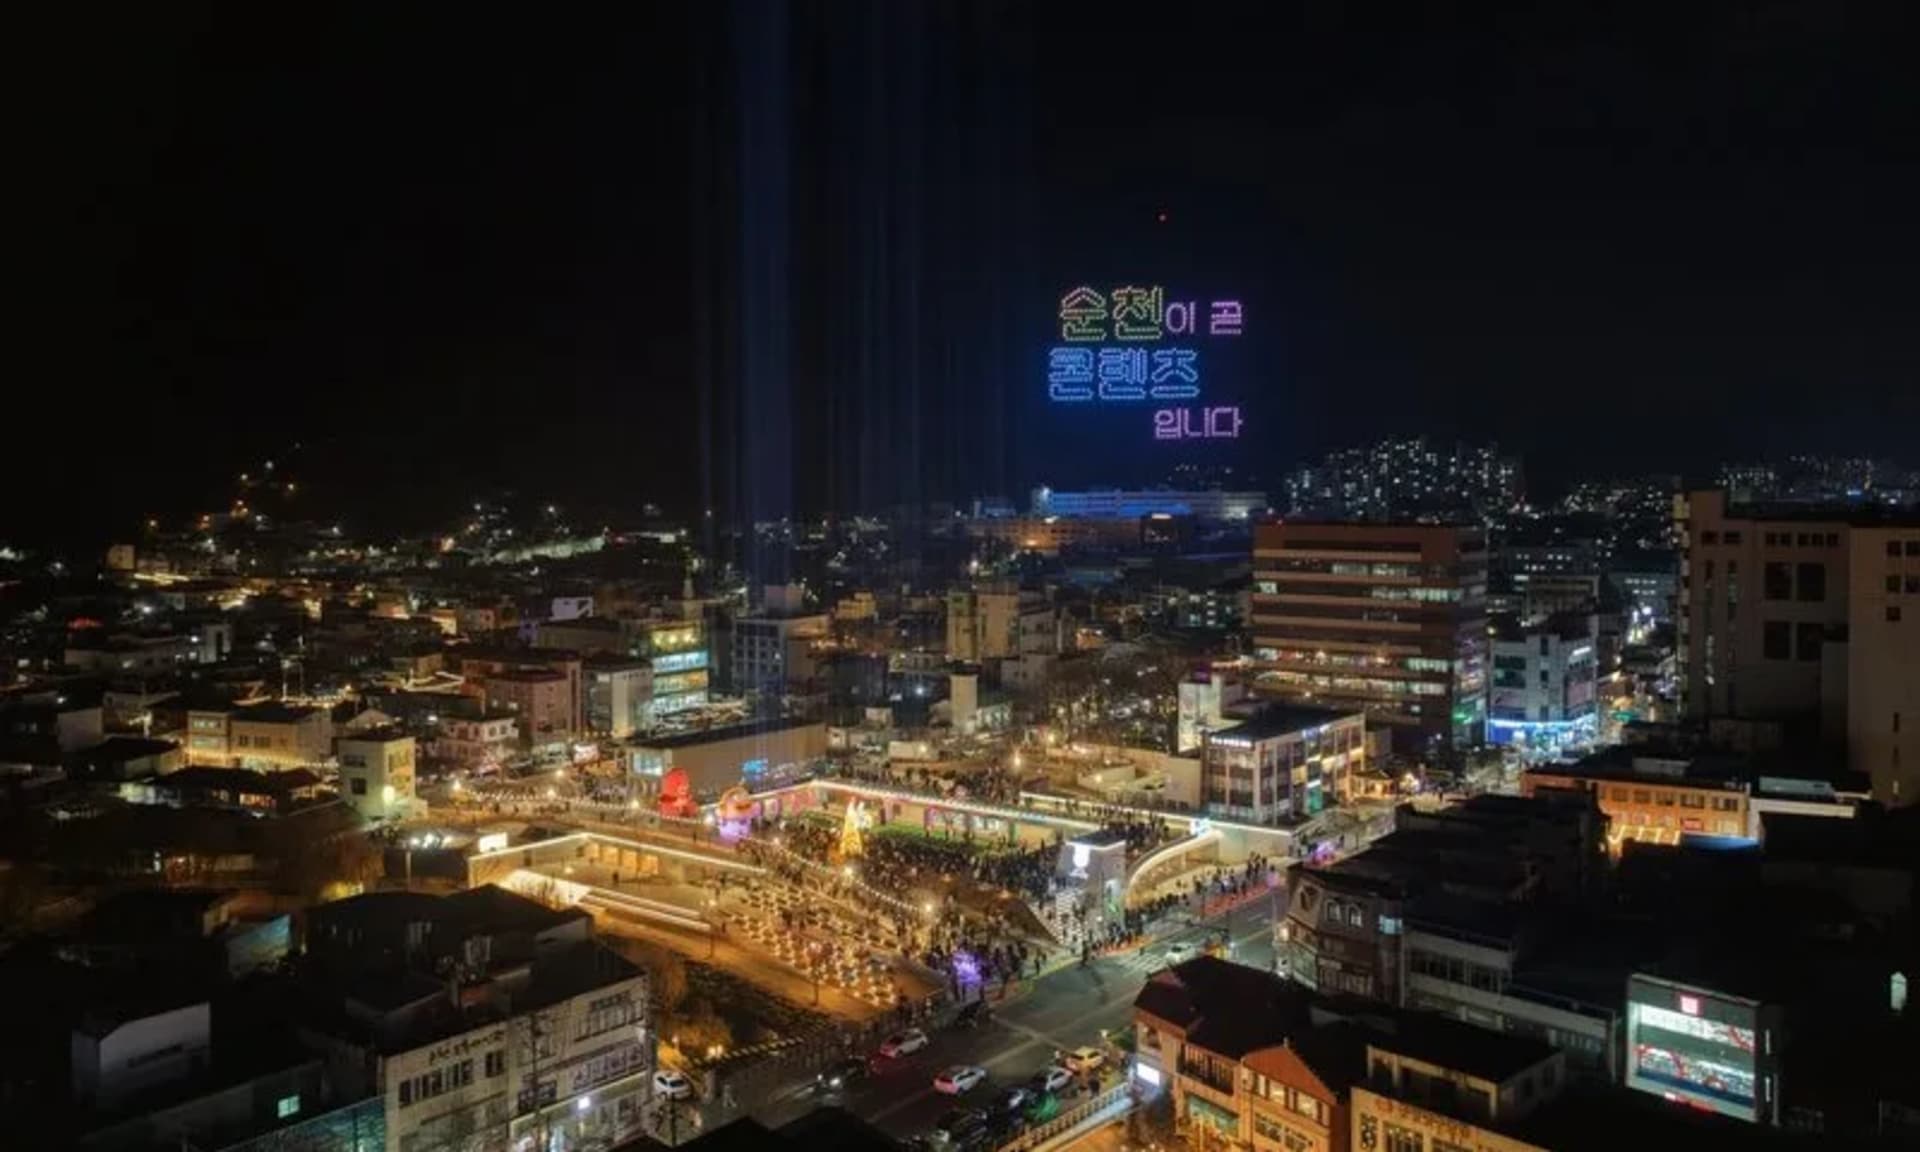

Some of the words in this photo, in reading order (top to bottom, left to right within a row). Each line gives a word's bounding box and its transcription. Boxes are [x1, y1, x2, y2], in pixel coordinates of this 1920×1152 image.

[1060, 286, 1195, 341] 순천이
[1049, 347, 1200, 401] 콘텐츠
[1154, 407, 1243, 439] 입니다
